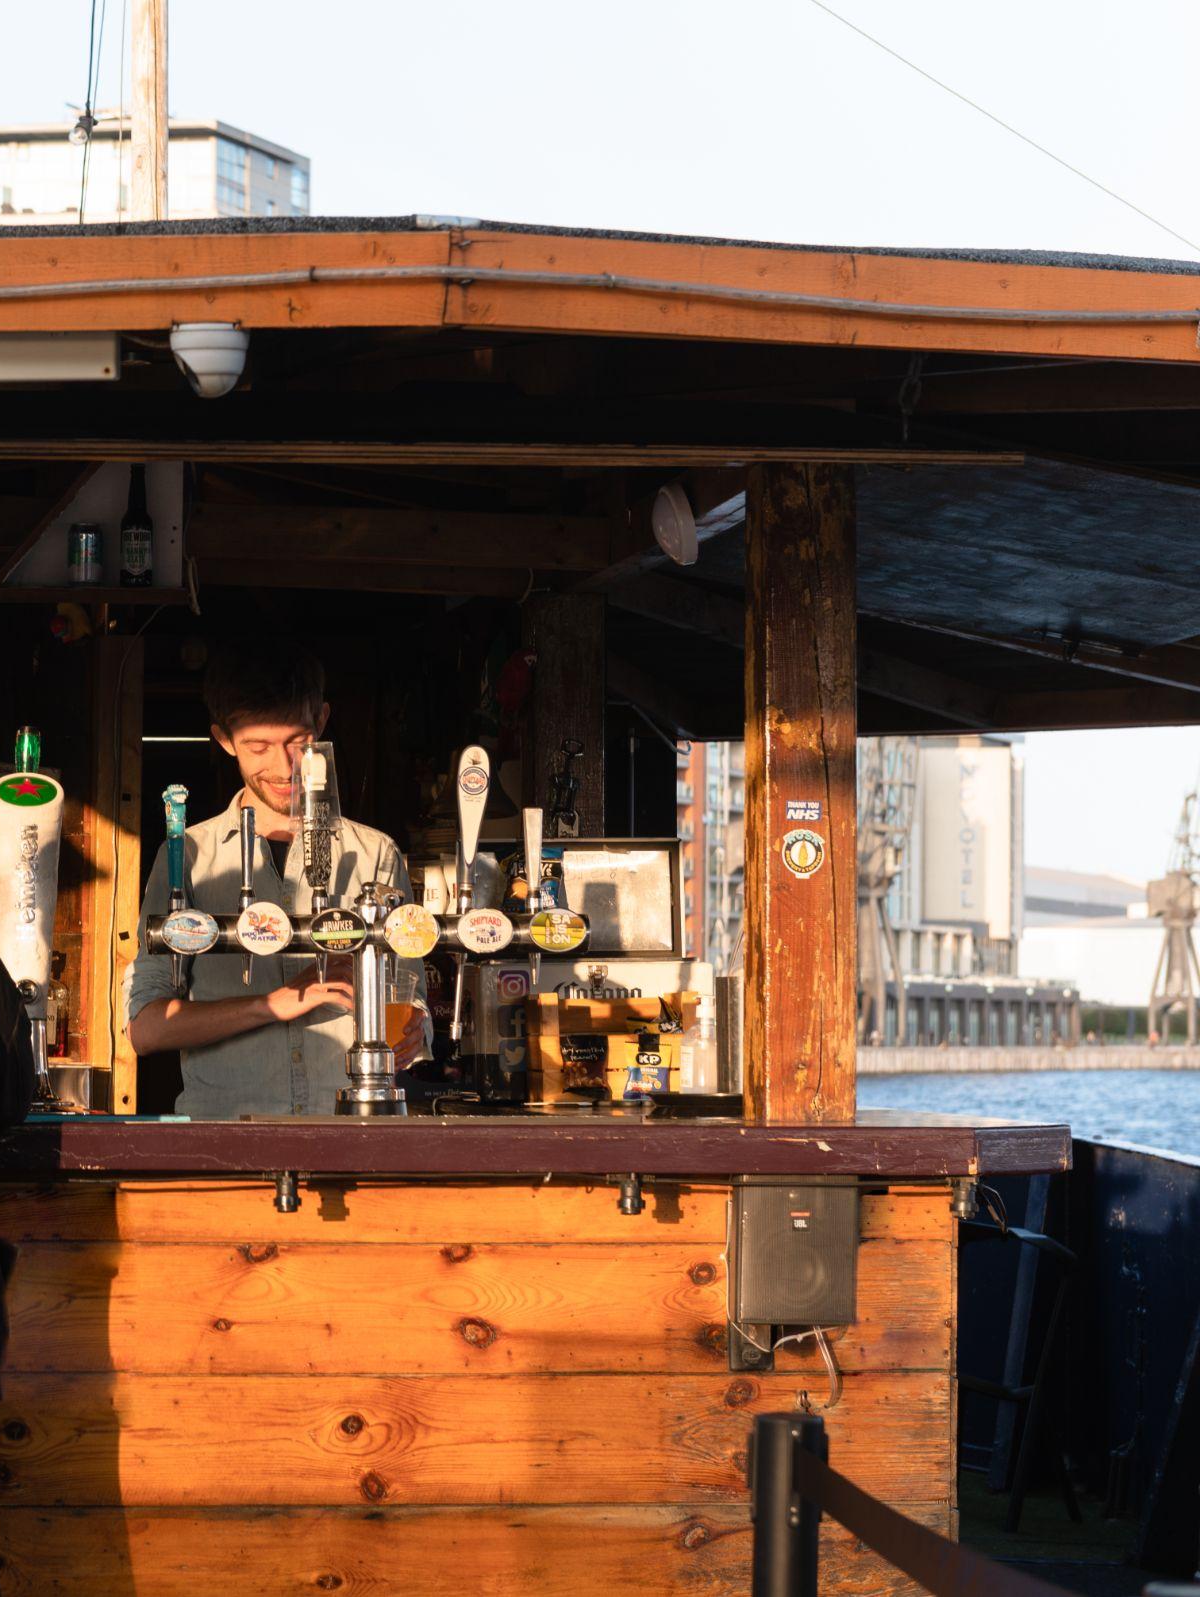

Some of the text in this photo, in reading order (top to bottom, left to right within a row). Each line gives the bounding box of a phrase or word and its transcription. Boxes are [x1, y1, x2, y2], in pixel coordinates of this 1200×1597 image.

[786, 809, 820, 820] NHS
[322, 920, 354, 932] HAWKES
[469, 916, 502, 928] SHIPYARD
[476, 934, 502, 944] PALE ALE
[552, 934, 571, 944] ON
[638, 1055, 661, 1066] KP
[793, 1219, 808, 1228] JBL
